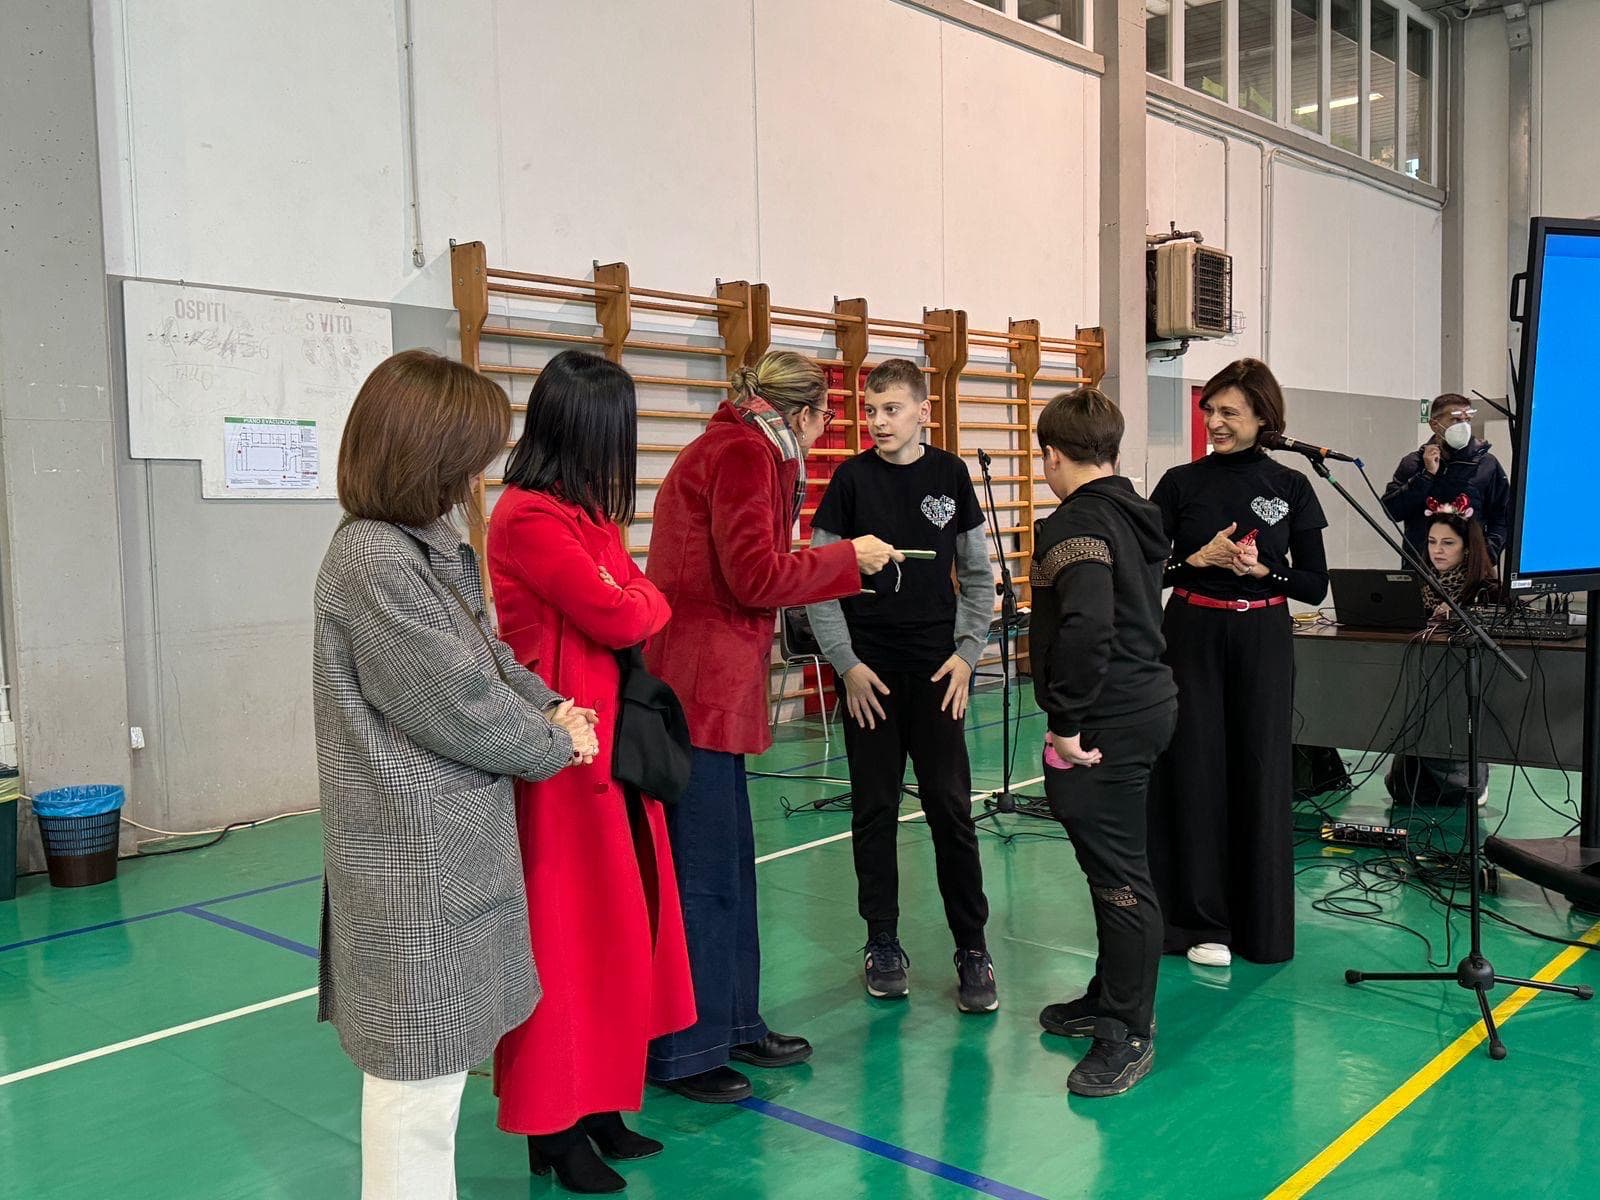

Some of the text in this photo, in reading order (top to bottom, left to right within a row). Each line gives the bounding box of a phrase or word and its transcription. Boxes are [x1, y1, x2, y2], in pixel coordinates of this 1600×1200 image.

[174, 298, 226, 323] OSPITI
[305, 312, 352, 335] S VITO
